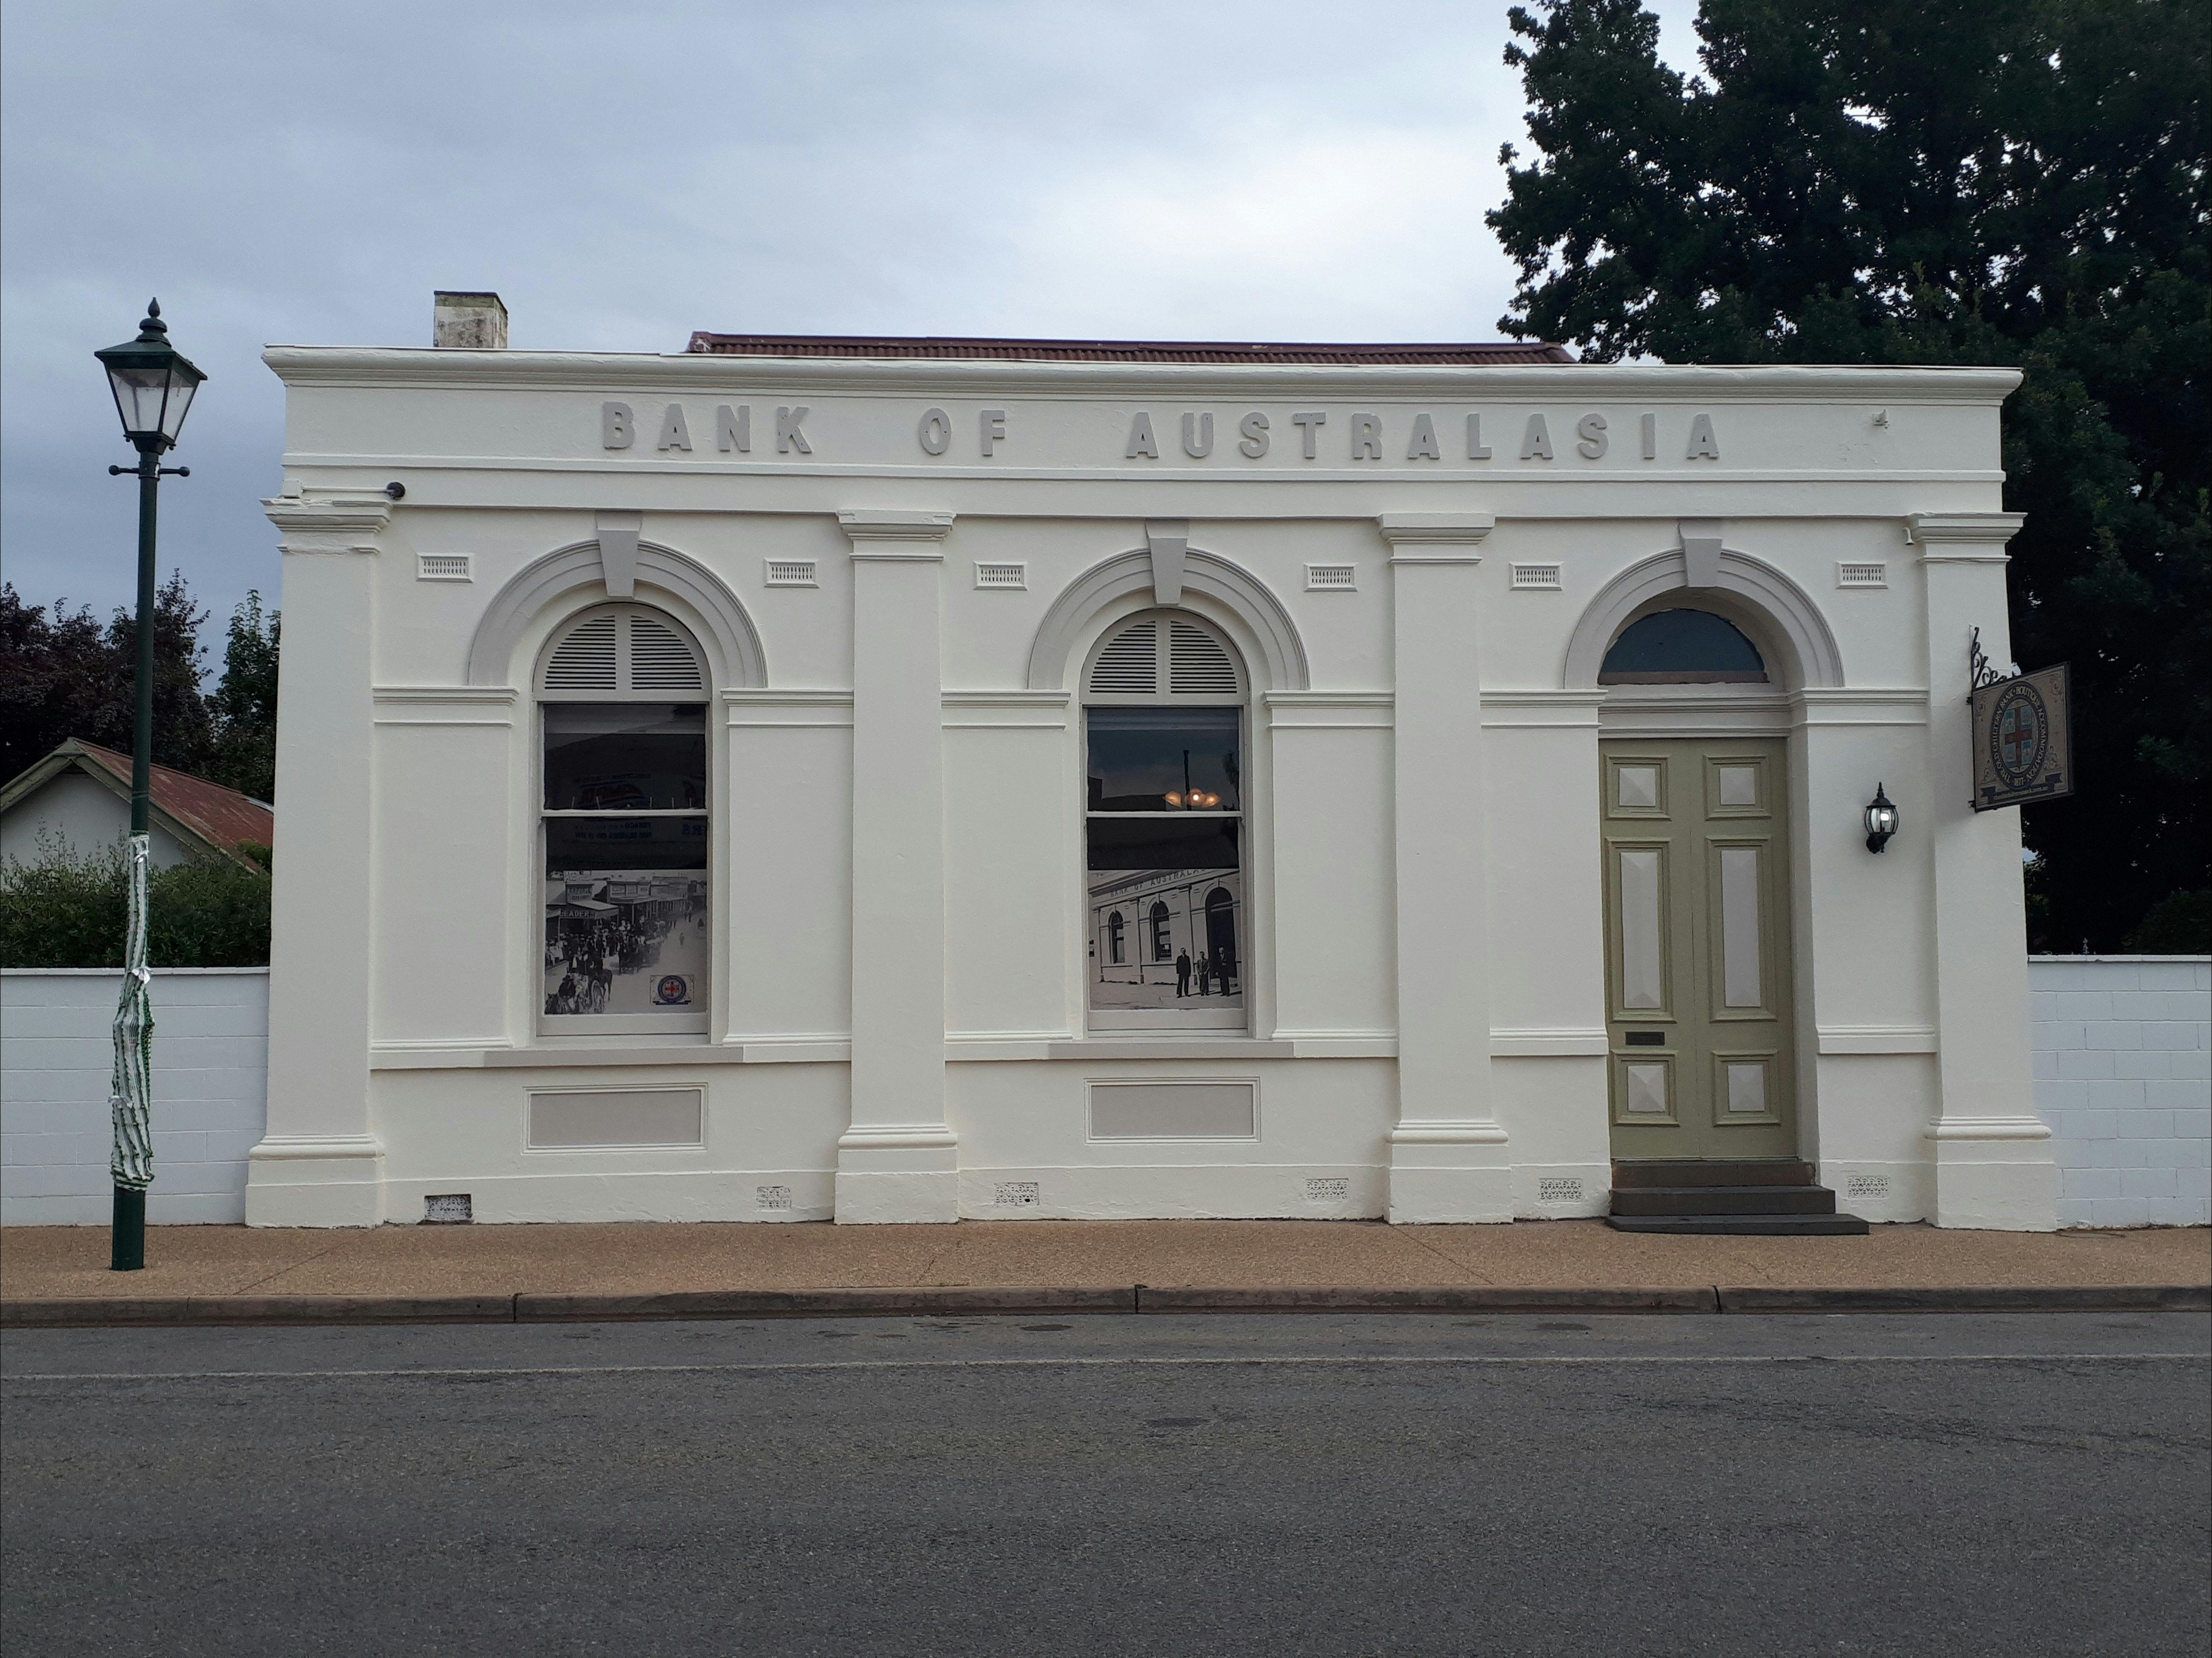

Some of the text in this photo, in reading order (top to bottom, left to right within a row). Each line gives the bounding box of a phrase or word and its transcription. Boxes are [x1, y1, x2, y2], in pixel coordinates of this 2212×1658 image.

[604, 401, 1720, 459] BANK OF AUSTRALASIA
[2016, 686, 2040, 708] BOUTIQUE
